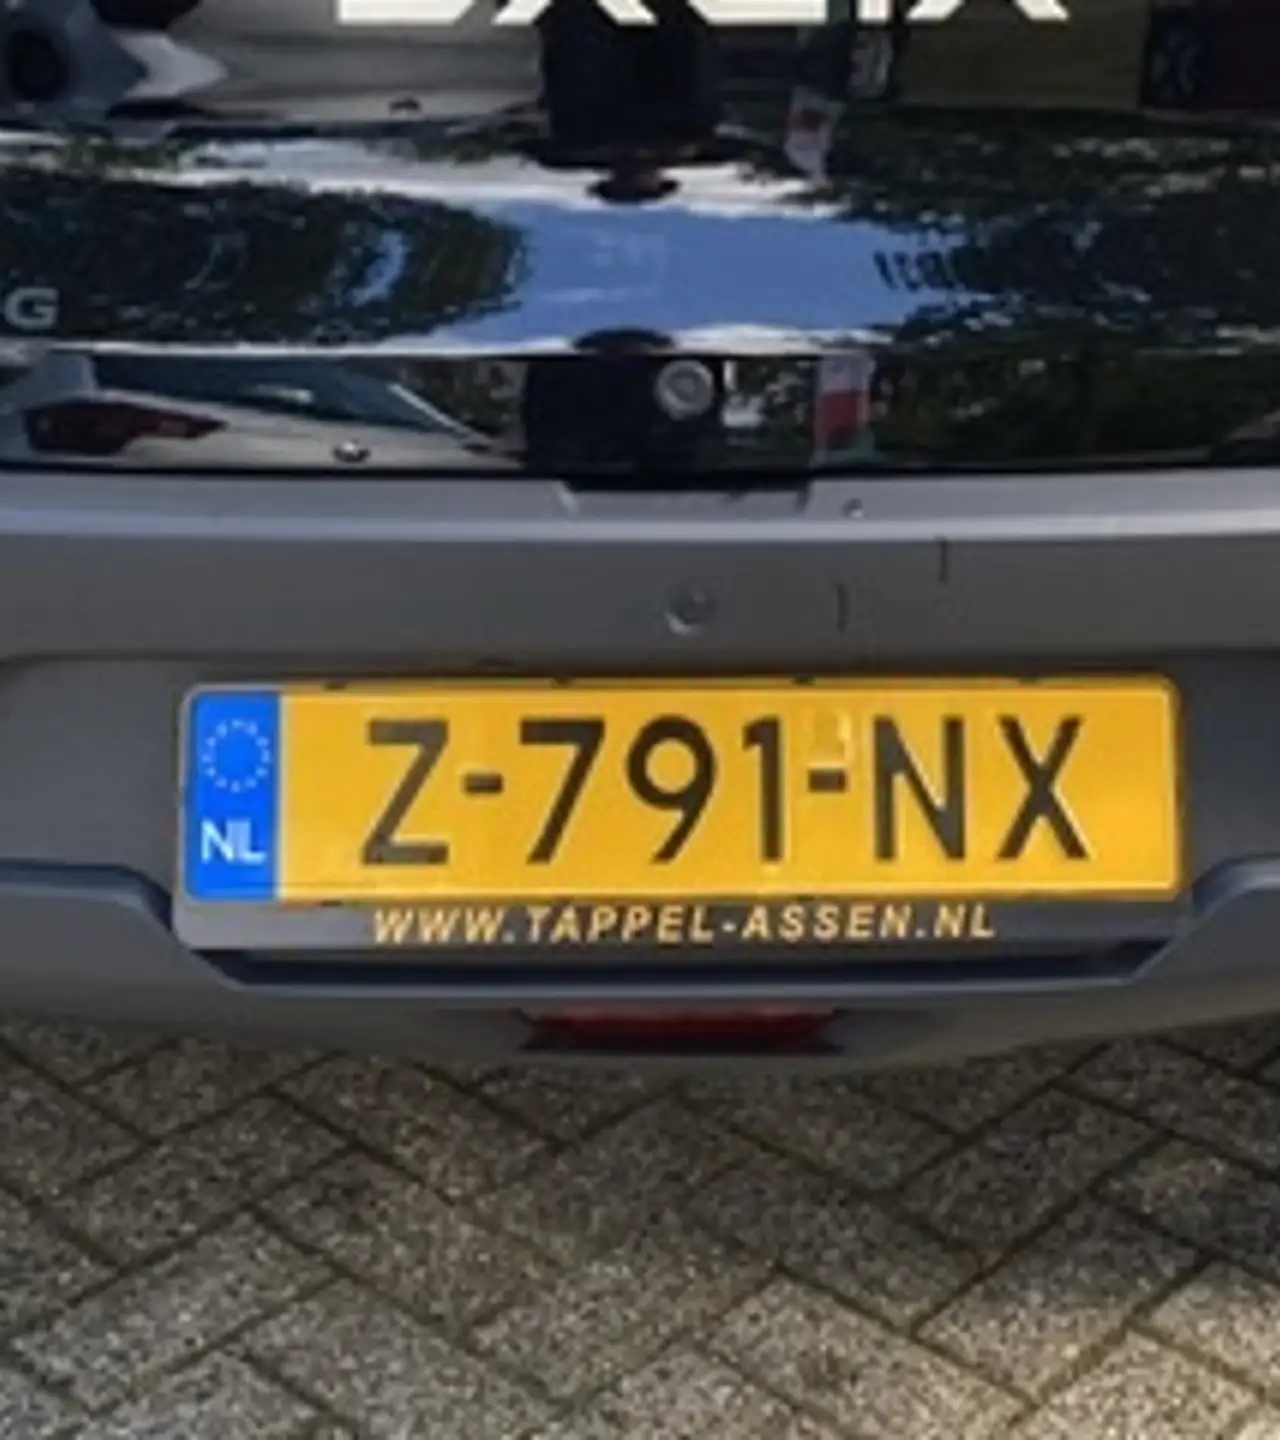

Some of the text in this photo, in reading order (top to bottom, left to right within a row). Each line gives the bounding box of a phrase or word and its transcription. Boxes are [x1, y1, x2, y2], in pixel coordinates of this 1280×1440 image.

[360, 714, 1090, 865] Z-791-NX
[200, 820, 267, 862] NL
[372, 905, 998, 945] WWW.TAPPEL-ASSEN.NL
